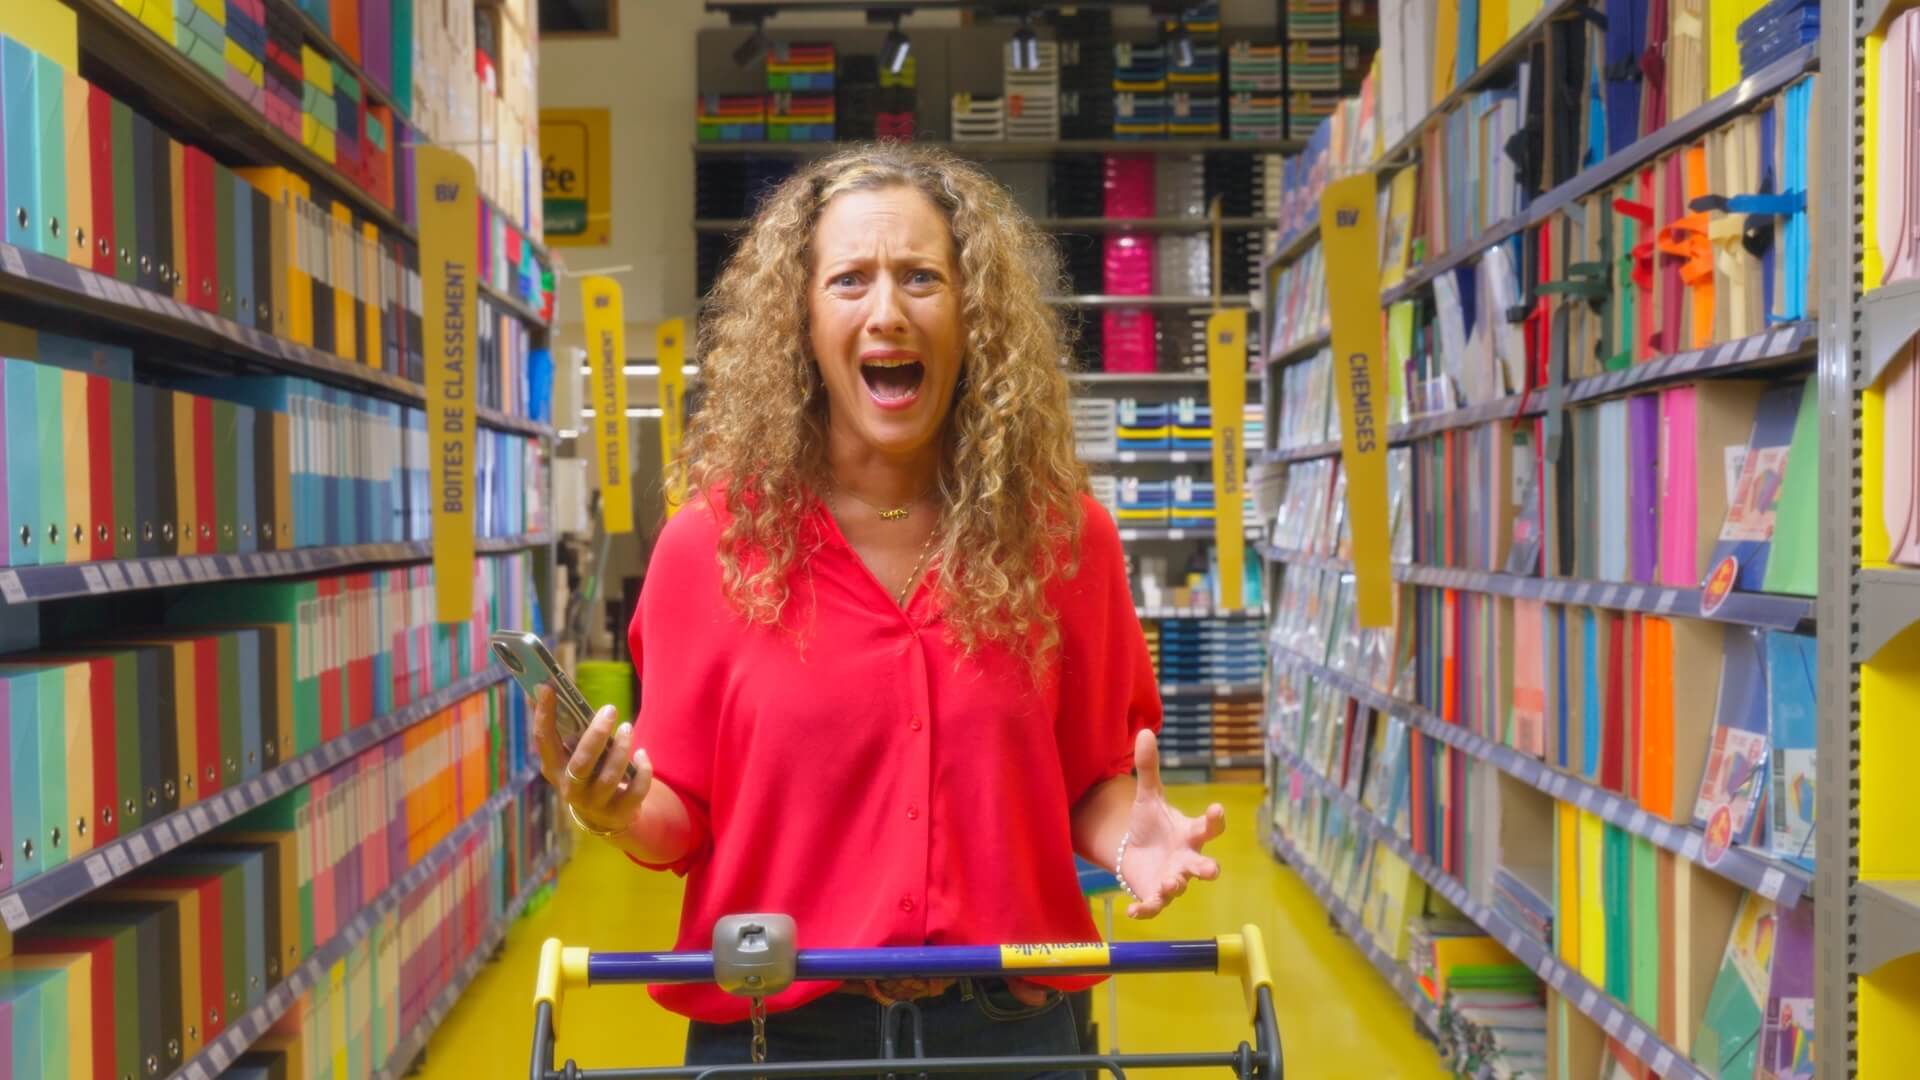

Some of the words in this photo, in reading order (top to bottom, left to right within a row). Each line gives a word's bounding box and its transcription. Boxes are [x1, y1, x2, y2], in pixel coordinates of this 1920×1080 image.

[435, 184, 459, 202] BV
[1336, 209, 1359, 228] BV
[444, 261, 465, 401] CLASSEMENT
[442, 407, 463, 434] DE
[1349, 353, 1376, 453] CHEMISES
[442, 440, 463, 514] BOITES
